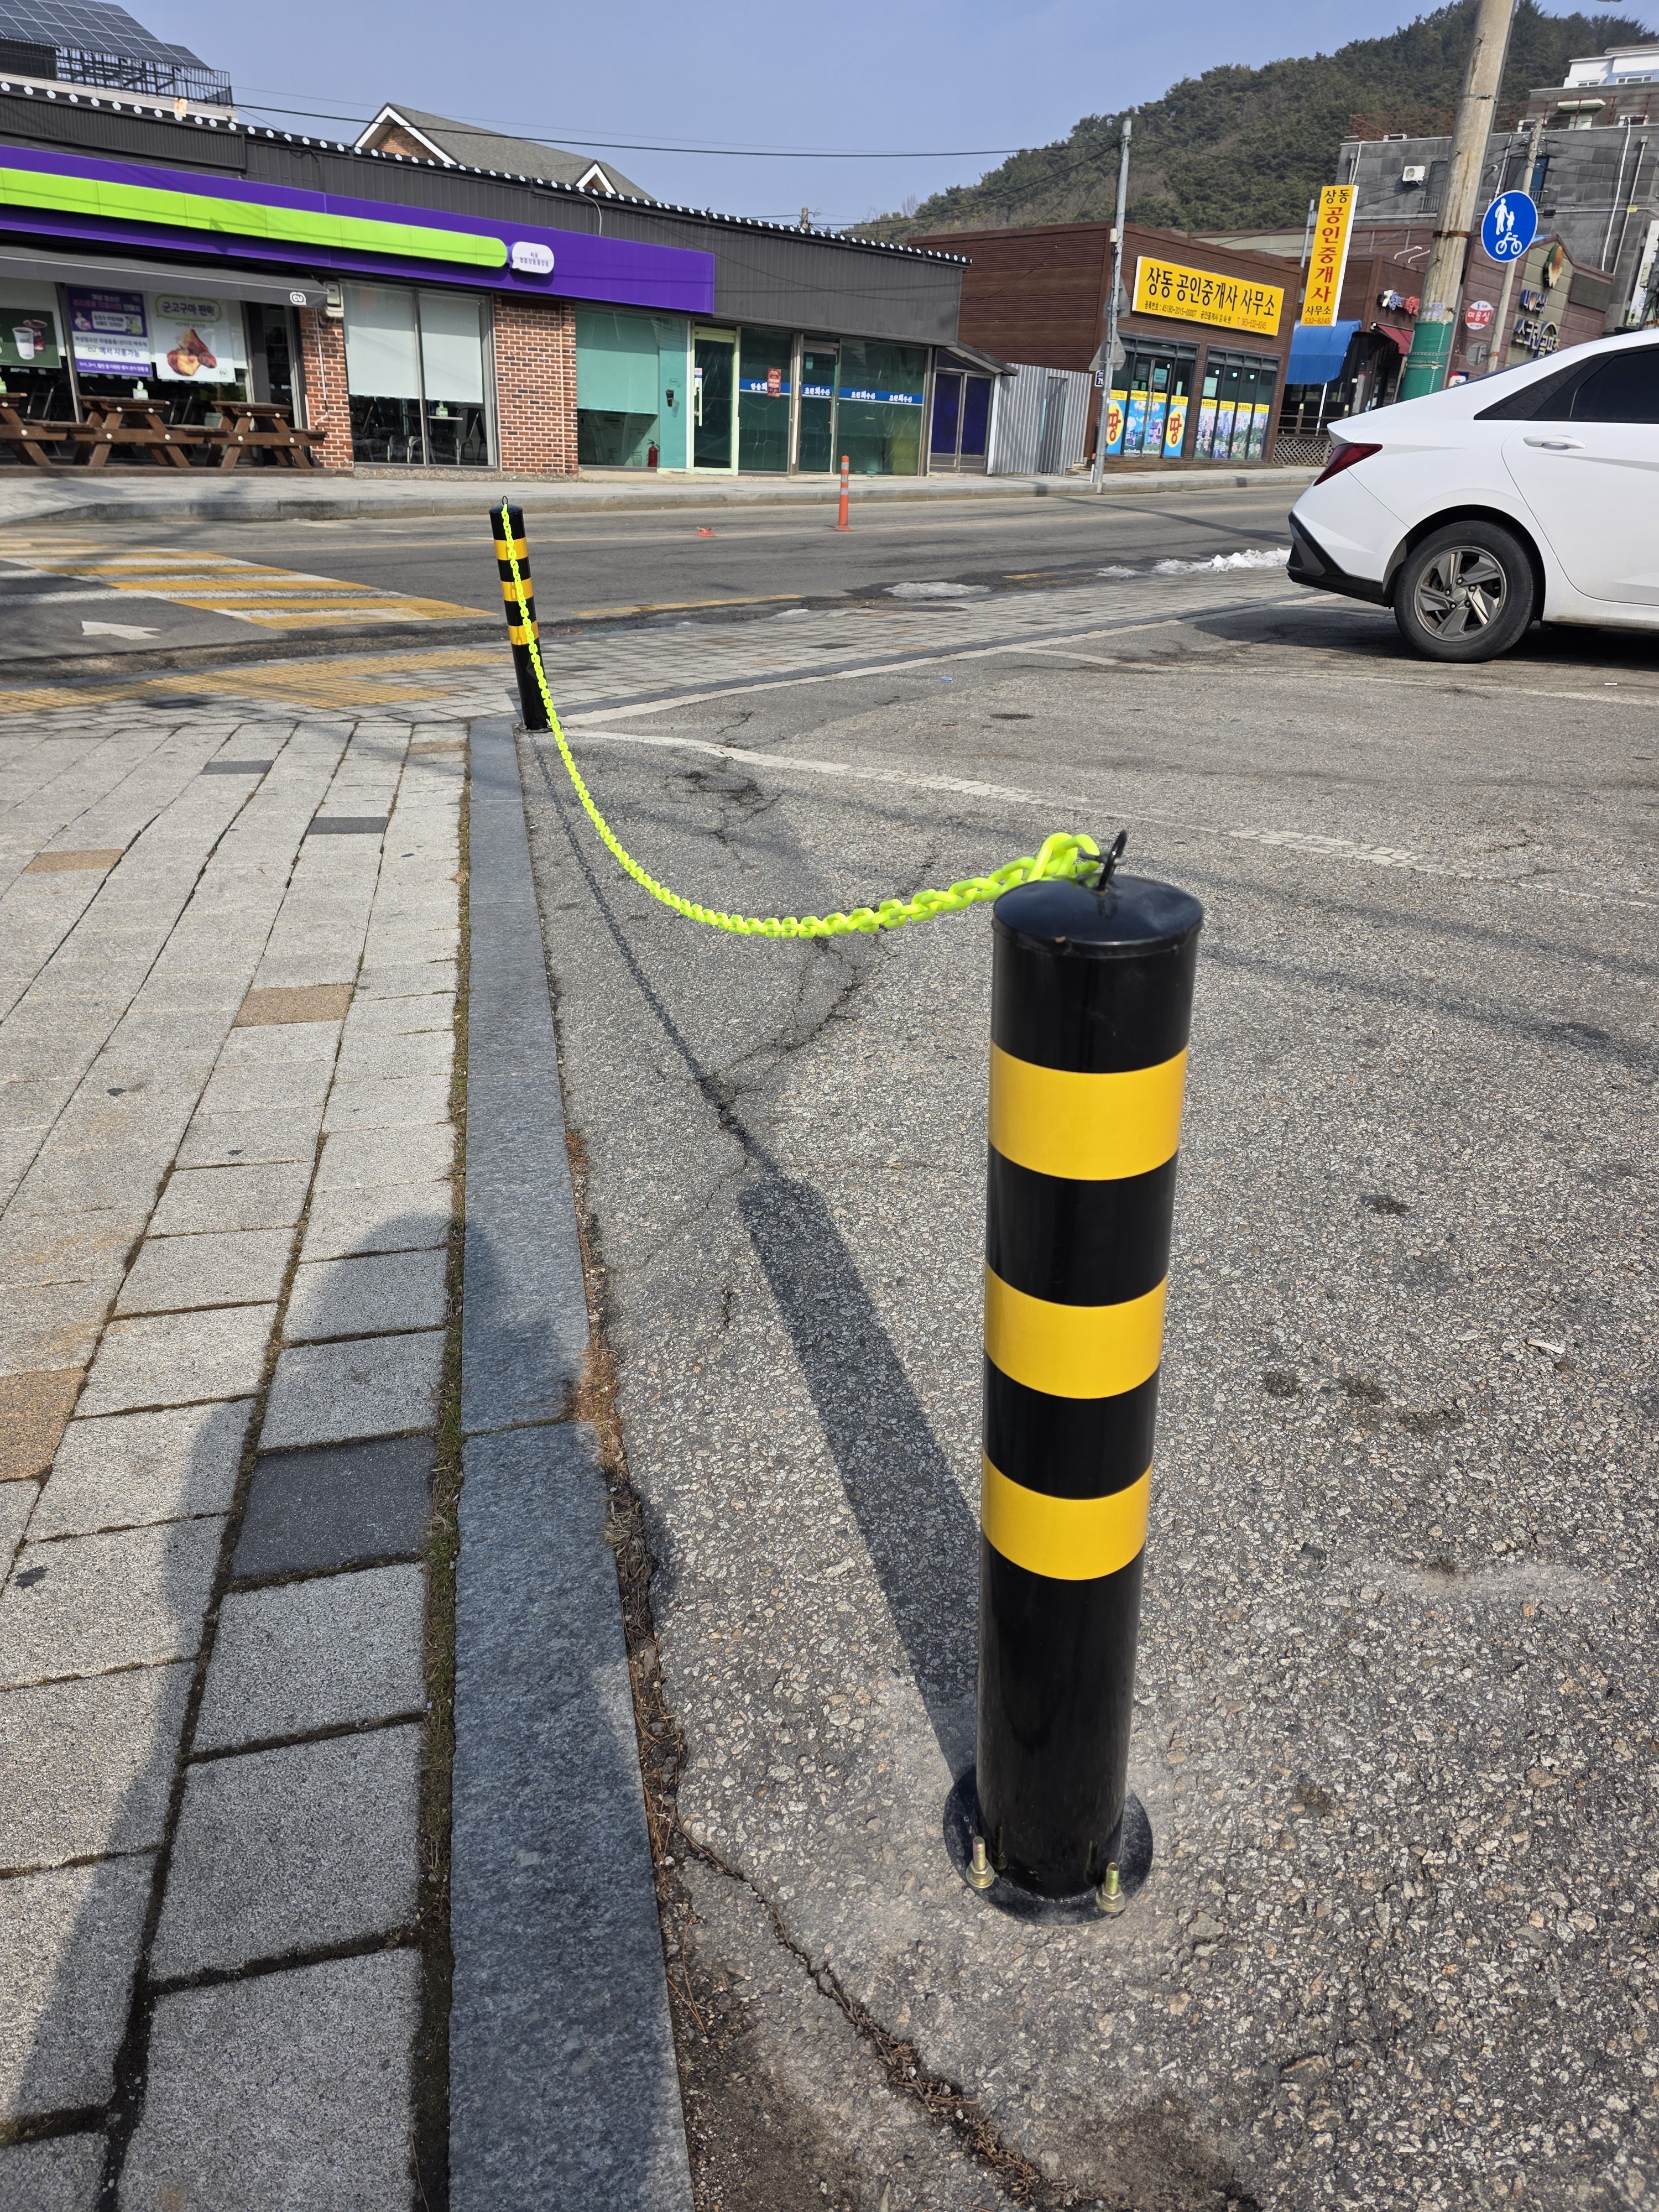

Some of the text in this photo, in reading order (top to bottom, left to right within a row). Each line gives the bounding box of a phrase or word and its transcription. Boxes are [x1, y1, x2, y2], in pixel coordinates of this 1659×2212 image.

[1323, 189, 1350, 204] 상동
[1311, 207, 1344, 303] 공인중개사
[1146, 267, 1275, 316] 상동 공인중개사 사무소
[163, 301, 196, 315] 군고구마
[1305, 306, 1332, 316] 사무소
[1467, 311, 1491, 322] 미용실
[1170, 414, 1182, 445] 땅
